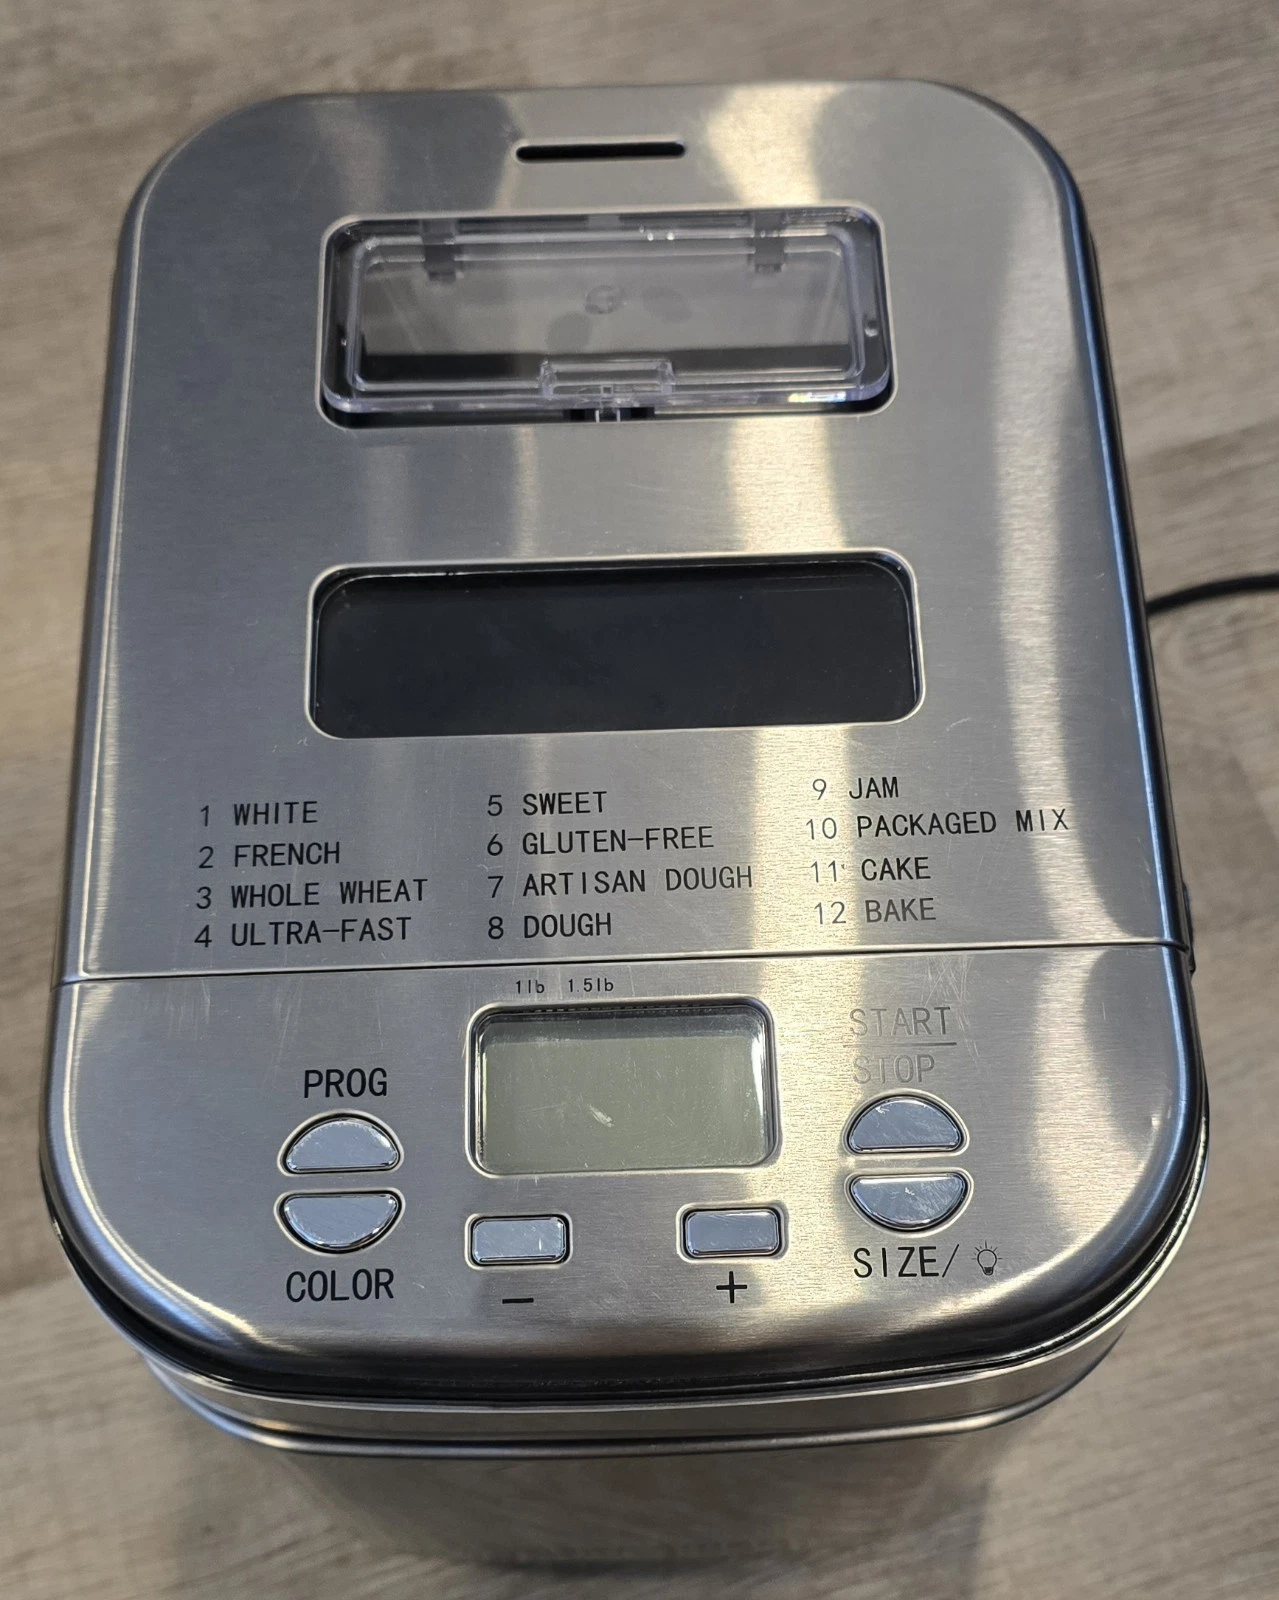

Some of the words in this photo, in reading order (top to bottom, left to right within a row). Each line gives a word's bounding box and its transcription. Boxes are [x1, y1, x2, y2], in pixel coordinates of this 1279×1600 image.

[486, 794, 503, 817] 5
[522, 790, 608, 816] SWEET
[812, 777, 827, 801] 9
[848, 775, 900, 800] JAM
[200, 804, 210, 827] 1
[232, 800, 319, 827] WHITE
[805, 816, 838, 841] 10
[856, 810, 997, 839] PACKAGED
[1015, 808, 1069, 833] MIX
[198, 845, 214, 869] 2
[233, 841, 341, 868] FRENCH
[486, 833, 503, 857] 6
[522, 825, 715, 856] GLUTEN-FREE
[487, 875, 504, 898] 7
[522, 868, 646, 897] ARTISAN
[665, 865, 753, 893] DOUGH
[810, 860, 839, 884] 11
[860, 856, 932, 882] CAKE
[196, 886, 212, 910] 3
[231, 881, 321, 908] WHOLE
[339, 878, 429, 905] WHEAT
[487, 916, 504, 941] 8
[523, 912, 612, 940] DOUGH
[813, 900, 847, 925] 12
[865, 897, 937, 924] BAKE
[194, 924, 213, 948] 4
[231, 916, 412, 947] ULTRA-FAST
[515, 980, 546, 994] 1lb
[567, 977, 615, 993] 1.5lb
[849, 1006, 951, 1038] START
[303, 1067, 388, 1098] PROG
[852, 1053, 936, 1085] STOP
[852, 1243, 960, 1279] SIZE/
[285, 1268, 395, 1303] COLOR
